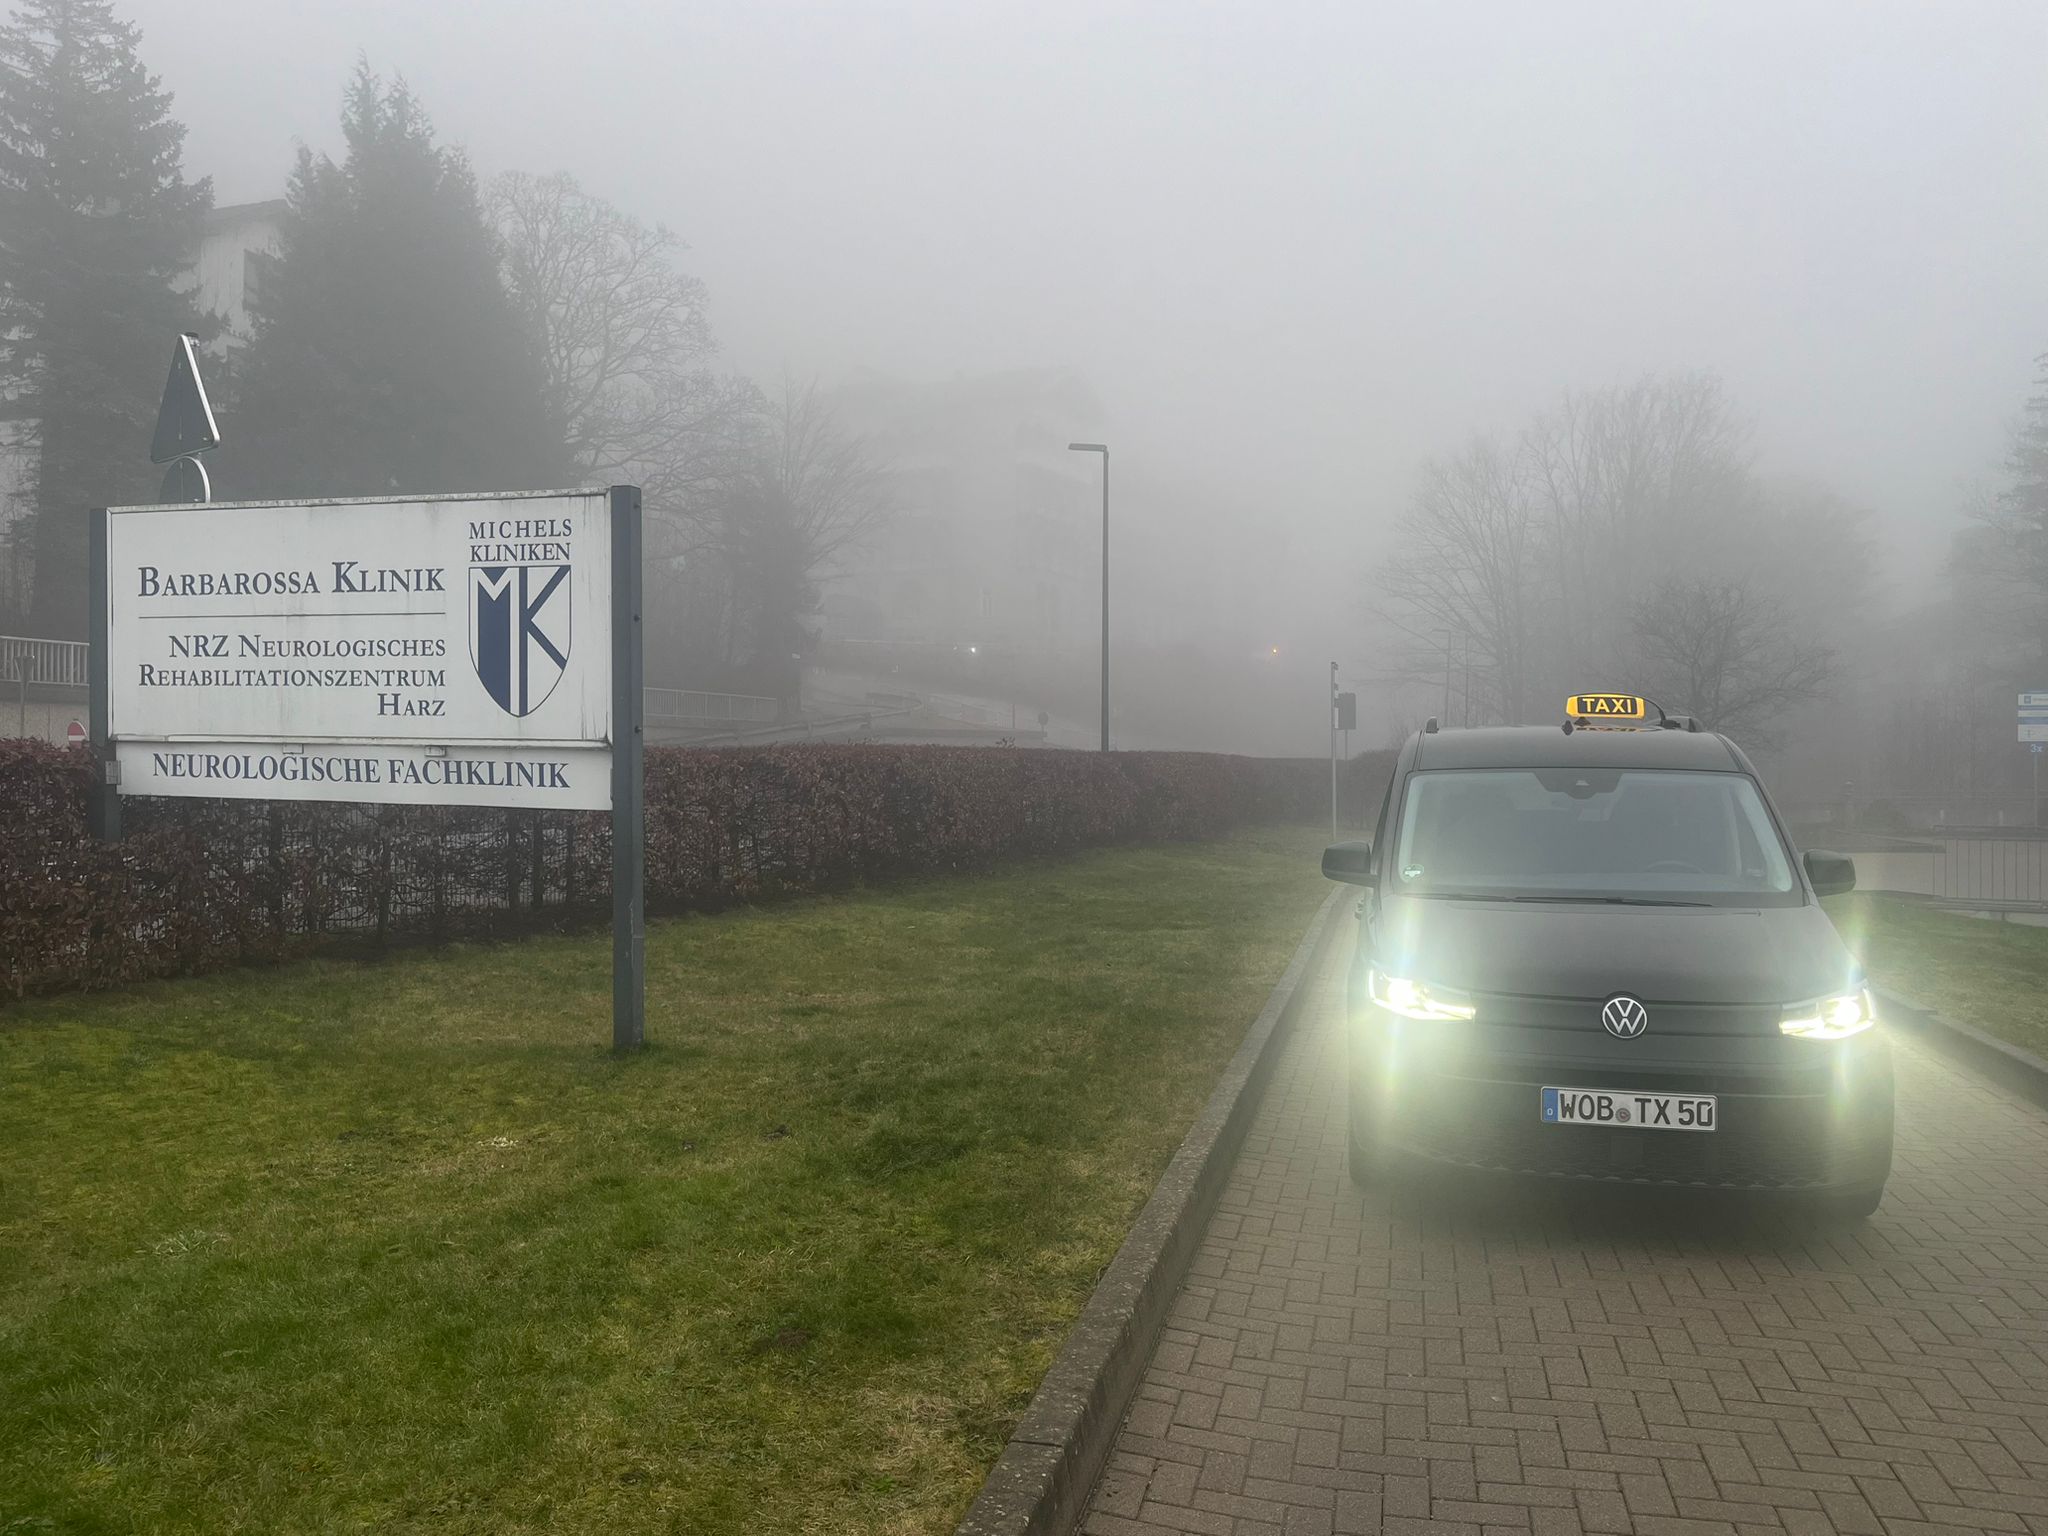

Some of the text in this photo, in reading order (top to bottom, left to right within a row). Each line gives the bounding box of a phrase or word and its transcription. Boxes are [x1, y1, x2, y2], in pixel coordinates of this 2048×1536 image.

[469, 518, 573, 540] MICHELS
[470, 542, 571, 563] KLINIKEN
[138, 561, 446, 598] BARBAROSSA KLINIK
[169, 634, 446, 658] NRZ NEUROLOGISCHES
[138, 663, 446, 688] REHABILITATIONSZENTRUM
[376, 693, 446, 717] HARZ
[1582, 698, 1632, 713] TAXI
[153, 753, 571, 788] NEUROLOGISCHE FACHKLINIK
[1559, 1093, 1713, 1127] WOB TX 50
